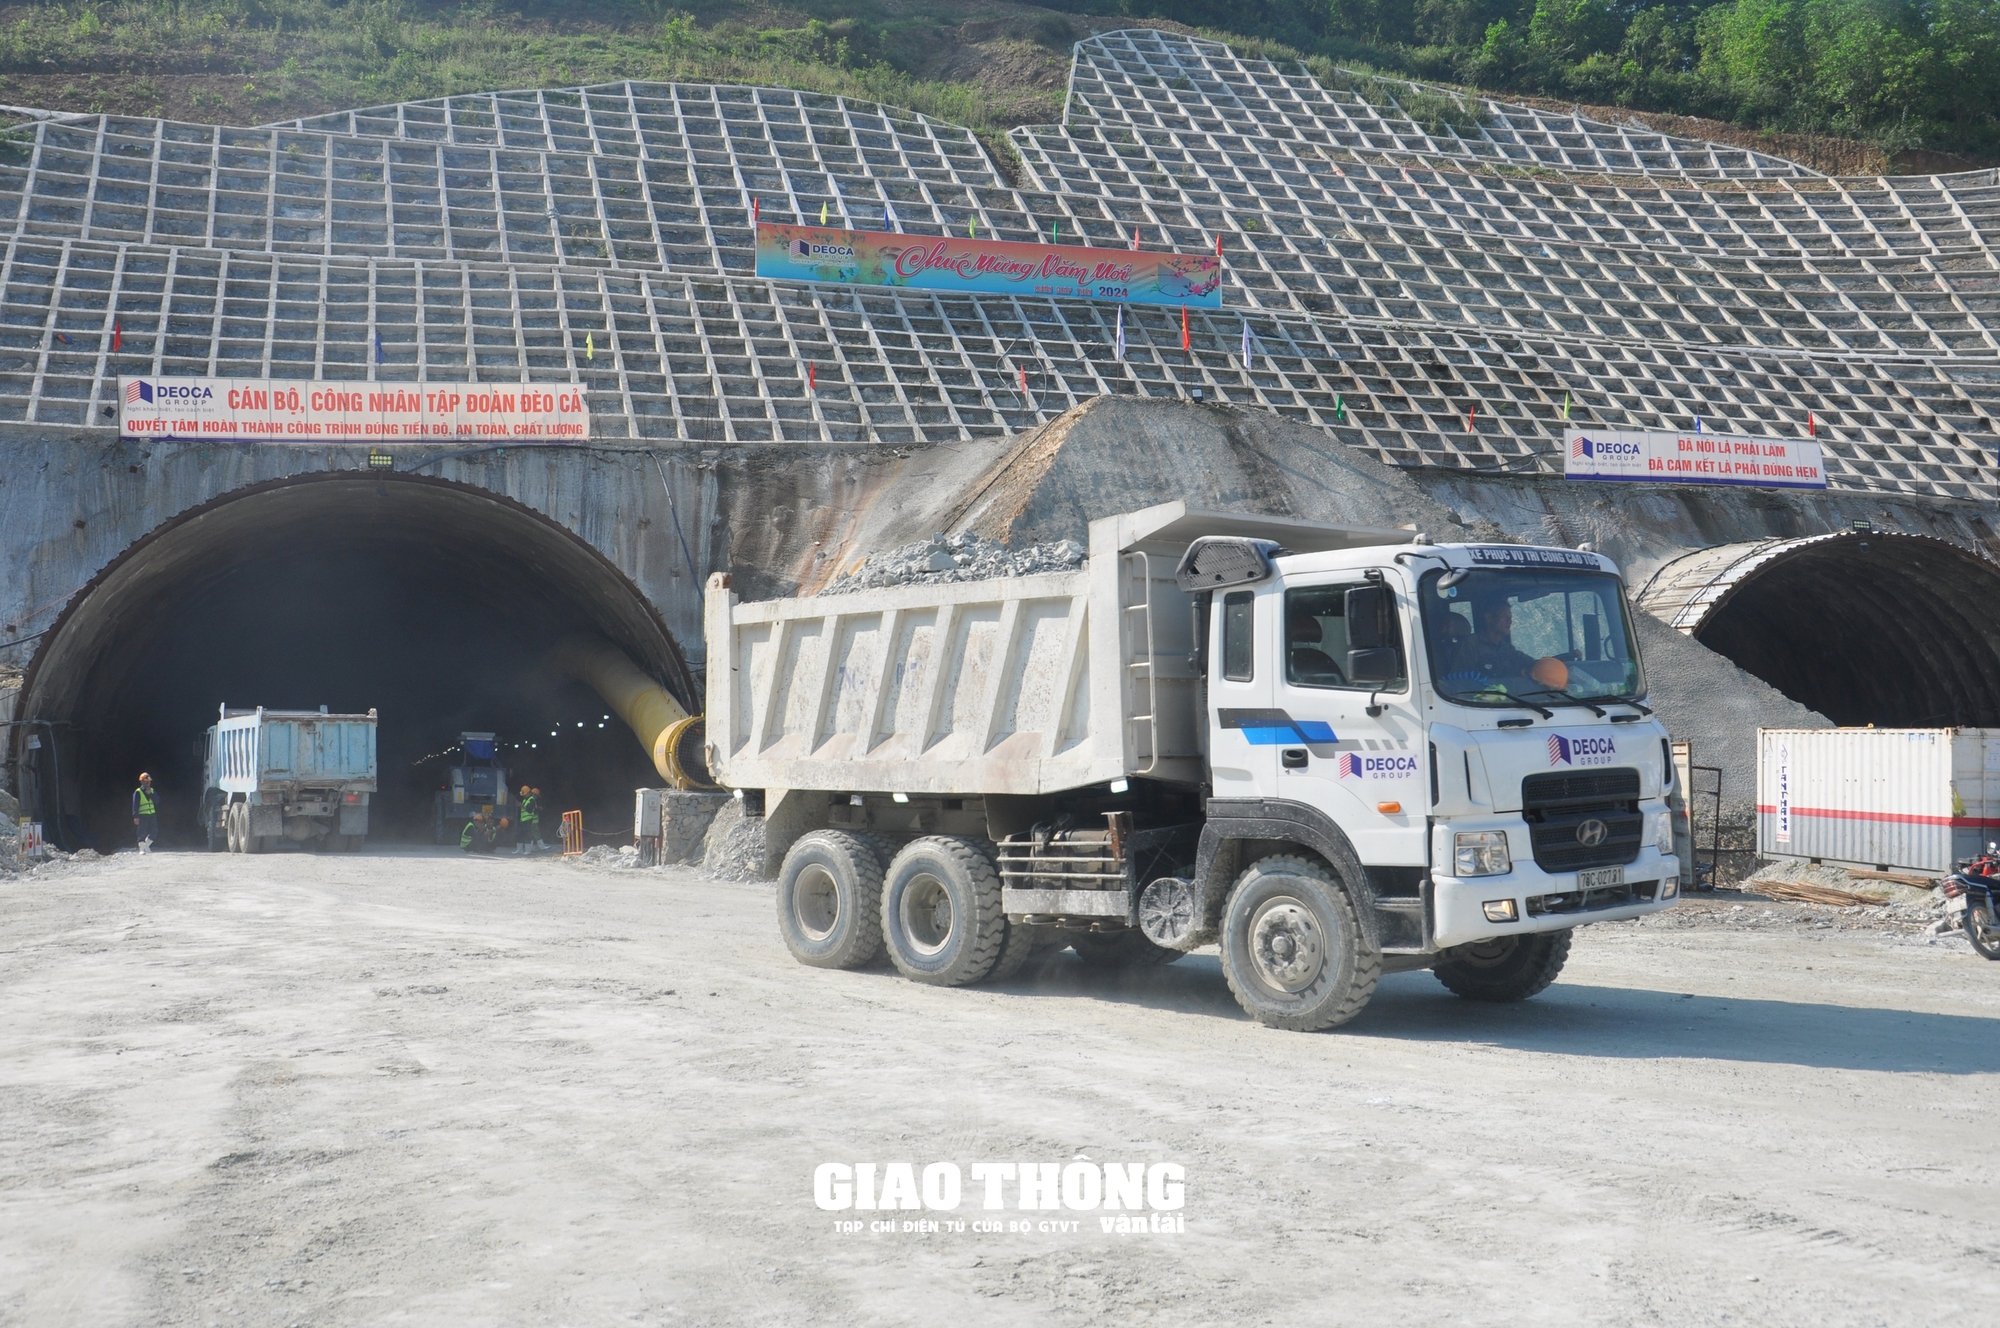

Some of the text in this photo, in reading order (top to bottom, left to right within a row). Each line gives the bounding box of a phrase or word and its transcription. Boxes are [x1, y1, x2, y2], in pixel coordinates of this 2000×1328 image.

[812, 244, 854, 256] DEOCA
[894, 240, 1132, 286] Chúc Mừng Năm Mới
[1098, 286, 1128, 298] 2024
[158, 386, 213, 398] DEOCA
[228, 386, 582, 416] CÁN BỘ, CÔNG NHÂN TẬP ĐOÀN ĐÈO CẢ
[128, 417, 583, 438] QUYẾT TÂM HOÀN THÀNH CÔNG TRÌNH ĐÚNG TIẾN ĐỘ, AN TOÀN, CHẤT LƯỢNG
[1596, 442, 1640, 454] DEOCA
[1678, 438, 1786, 457] ĐÃ NÓI LÀ PHẢI LÀM
[1648, 456, 1818, 480] ĐÃ CAM KẾT LÀ PHẢI ĐÚNG HẸN
[1469, 549, 1483, 560] XE
[1484, 549, 1510, 562] PHỤC
[1511, 550, 1524, 563] VỤ
[1524, 551, 1540, 562] THI
[1540, 551, 1566, 562] CÔNG
[1566, 554, 1582, 564] CAO
[1572, 738, 1616, 755] DEOCA
[1366, 757, 1417, 771] DEOCA
[1580, 756, 1612, 766] GROUP
